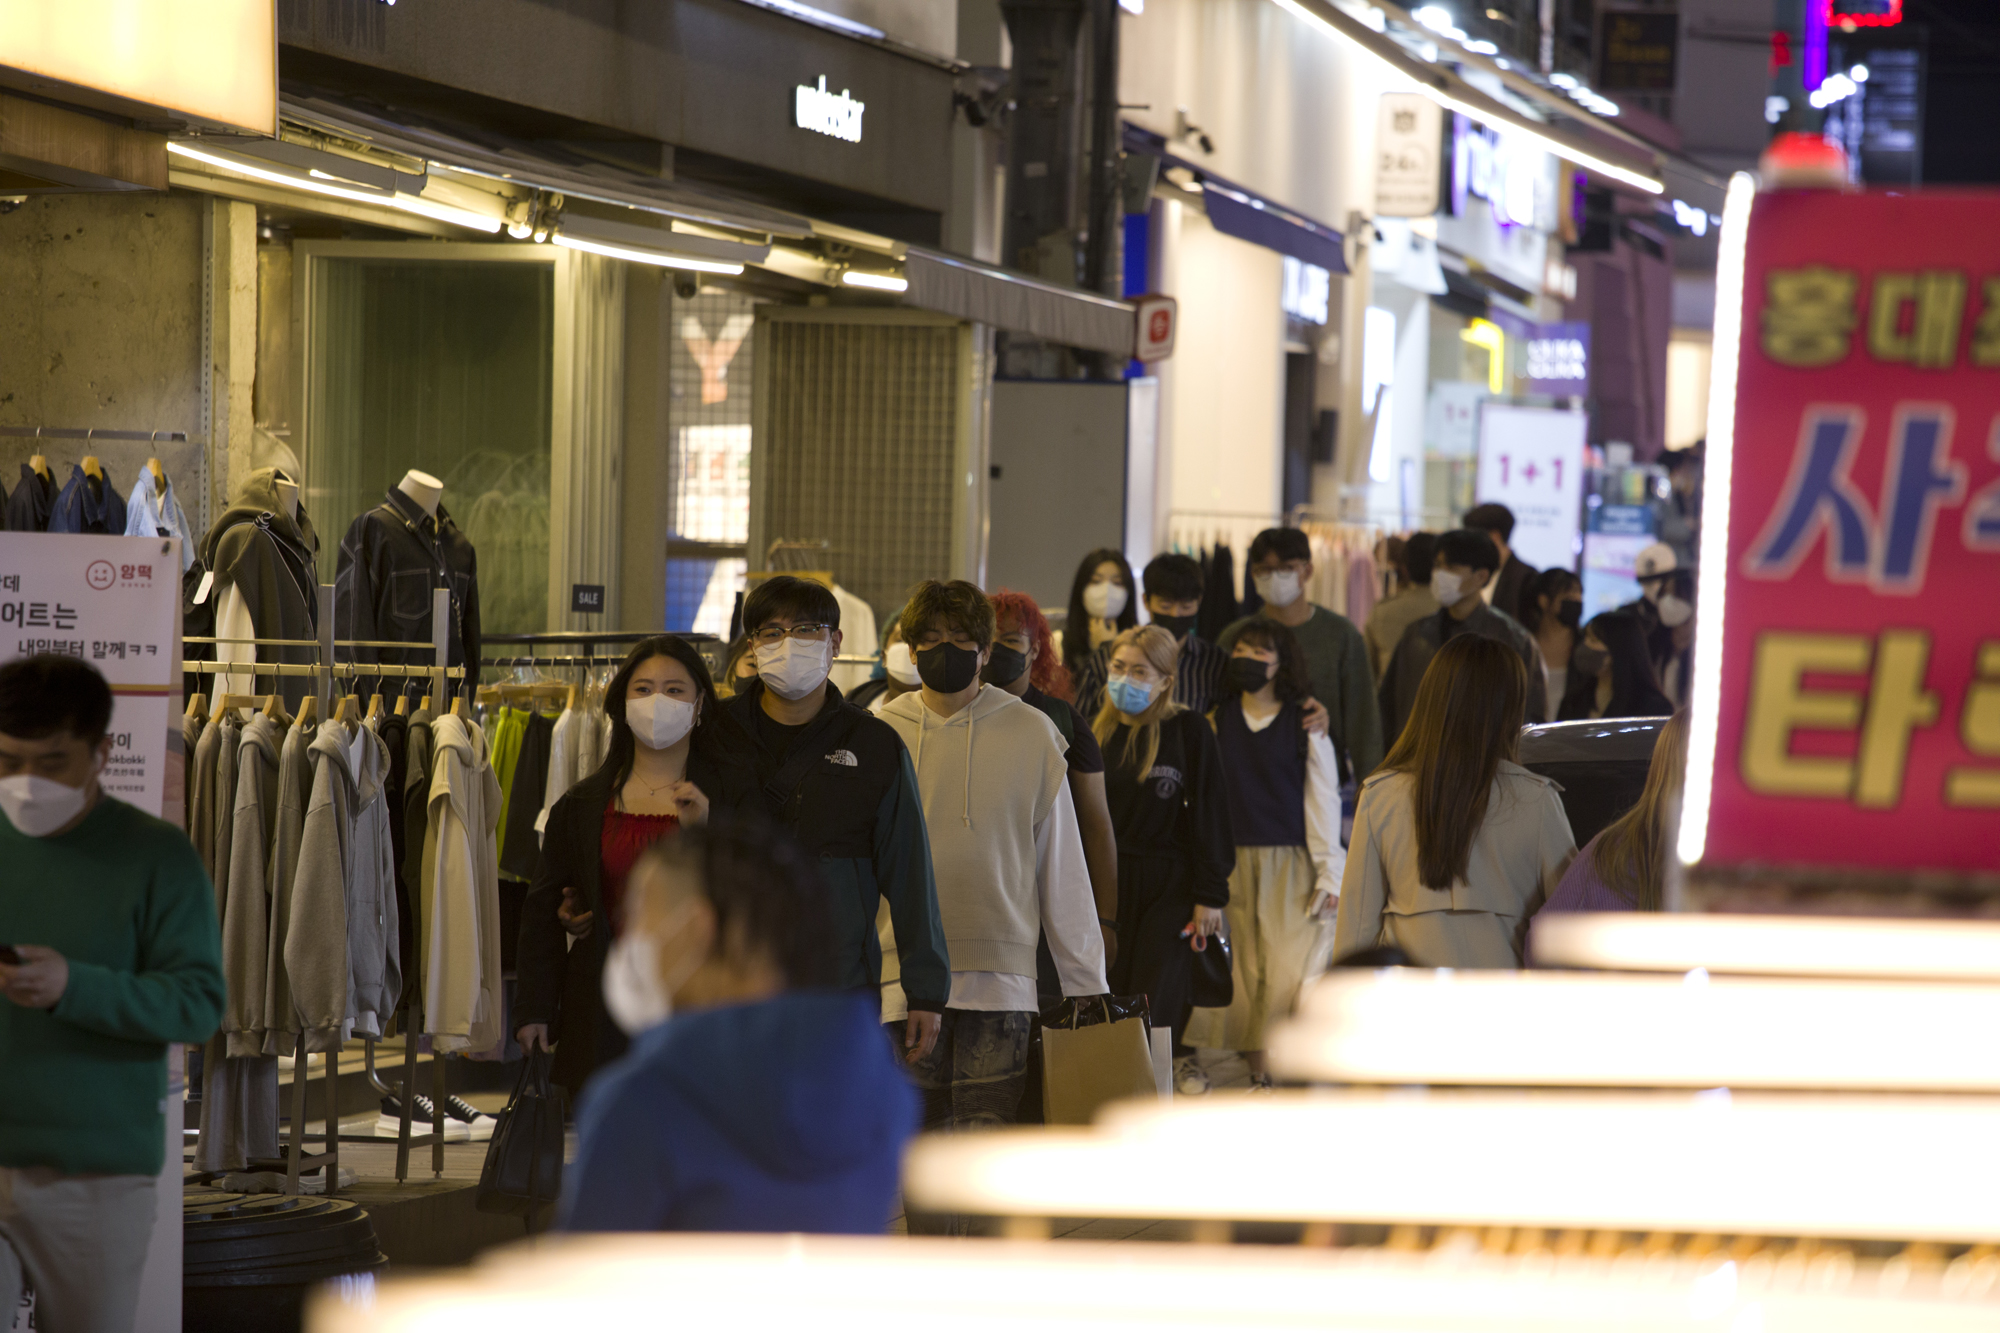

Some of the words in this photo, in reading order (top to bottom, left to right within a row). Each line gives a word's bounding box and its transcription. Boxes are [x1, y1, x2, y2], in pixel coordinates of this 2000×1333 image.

[0, 574, 20, 593] 데
[578, 591, 599, 605] SALE
[1, 601, 78, 630] 어트는
[107, 754, 146, 765] okbokki
